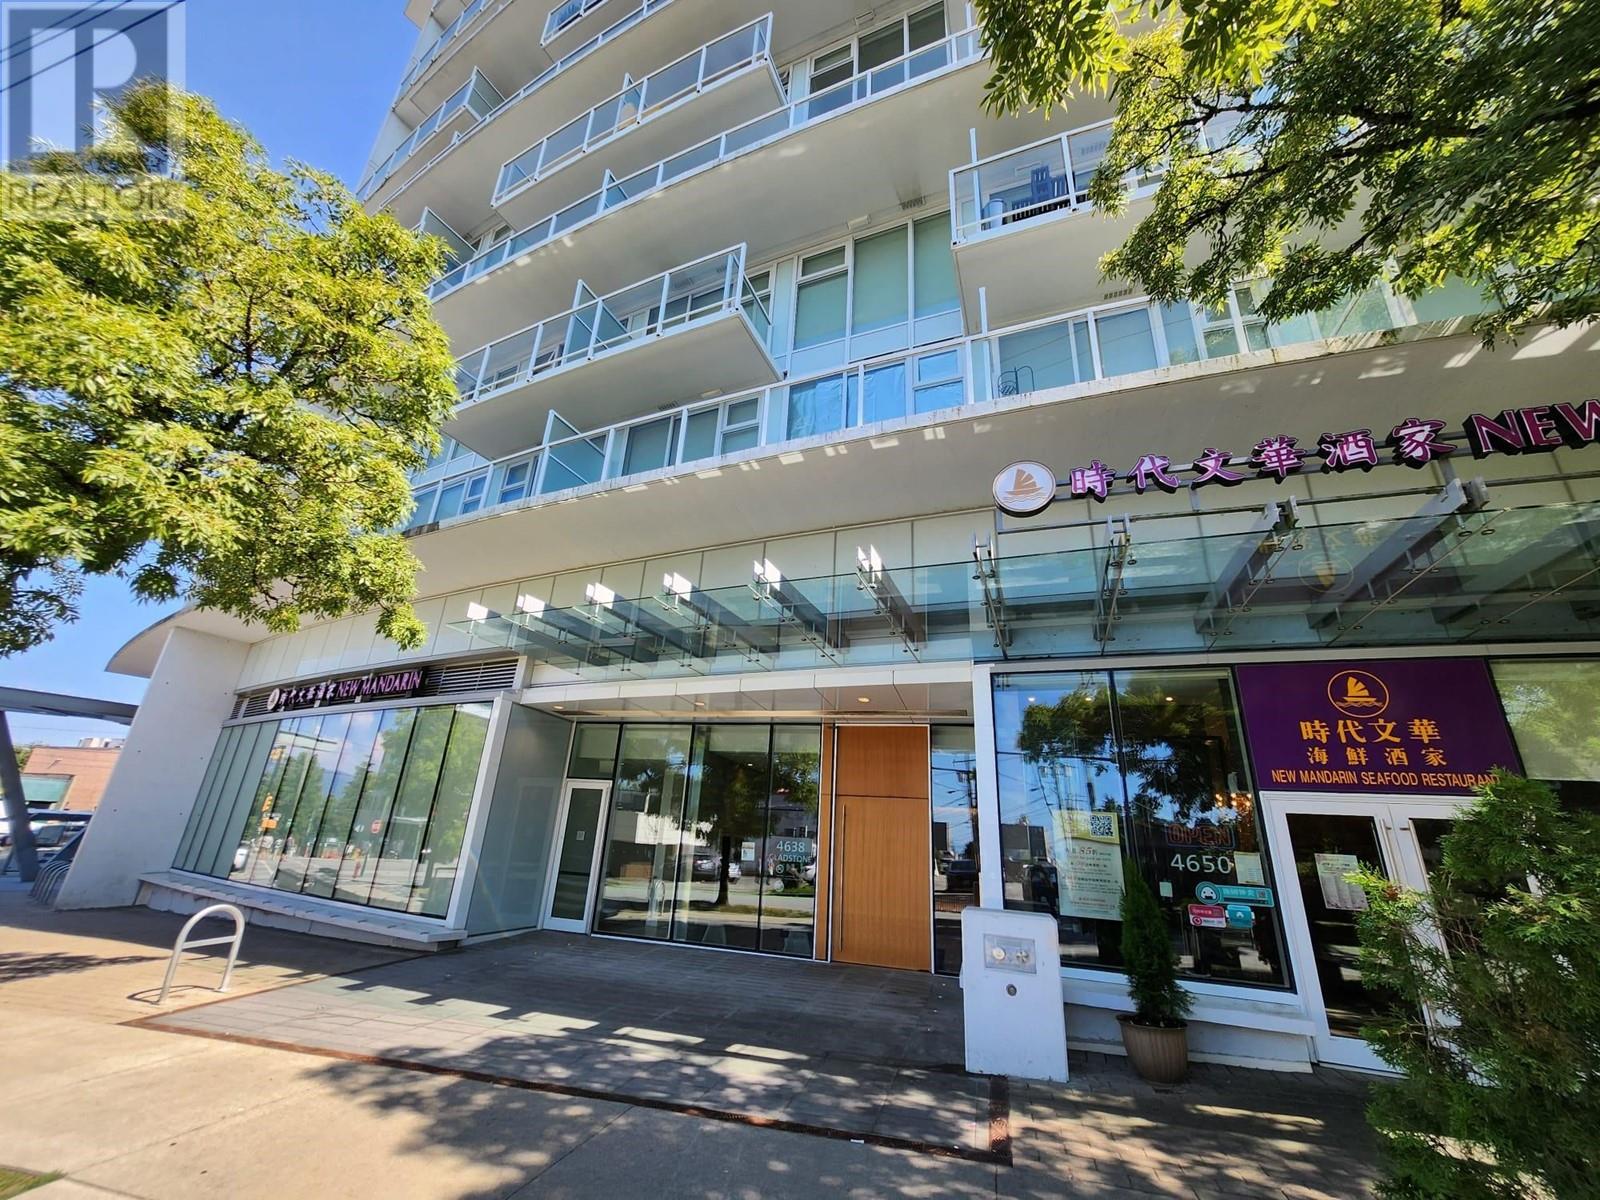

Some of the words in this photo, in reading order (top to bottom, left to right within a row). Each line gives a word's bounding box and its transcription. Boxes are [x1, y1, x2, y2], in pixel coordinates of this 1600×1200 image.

[1467, 399, 1600, 456] NEW
[1070, 417, 1457, 501] 時代文華酒家
[336, 680, 362, 698] NEW
[360, 671, 424, 696] MANDARIN
[1299, 718, 1442, 744] 時代文華
[1306, 747, 1448, 767] 海鮮酒家
[1271, 769, 1297, 784] NEW
[1300, 769, 1358, 785] MANDARIN
[1361, 771, 1419, 787] SEAFOOD
[1169, 824, 1231, 846] OPEN
[776, 840, 805, 853] 4638
[1170, 853, 1233, 874] 4650
